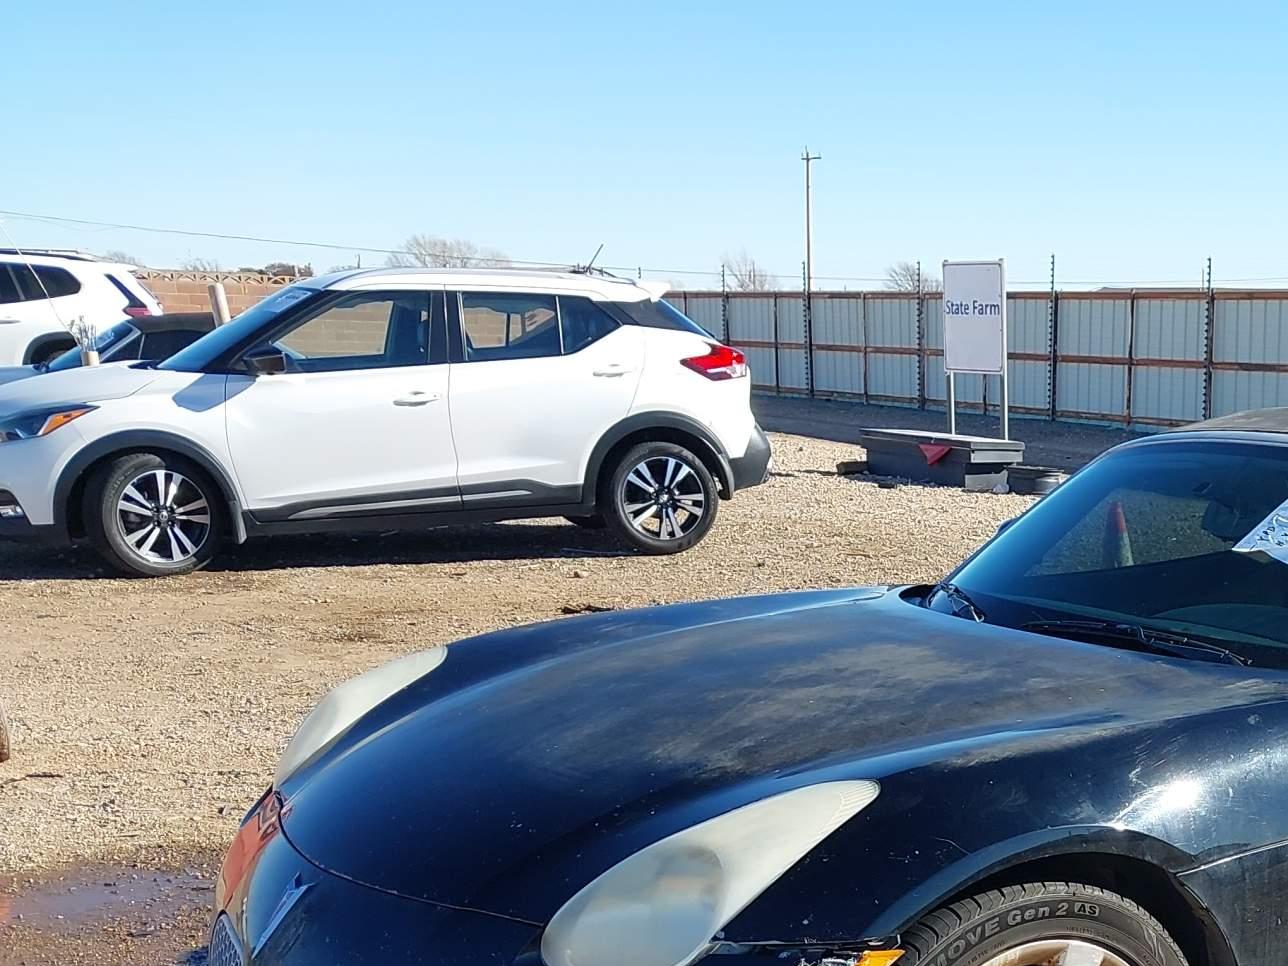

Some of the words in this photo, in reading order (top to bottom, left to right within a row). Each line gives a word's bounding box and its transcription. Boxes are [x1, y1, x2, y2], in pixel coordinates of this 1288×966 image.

[945, 300, 970, 315] State
[972, 300, 1000, 315] Farm
[1007, 904, 1050, 926] Gen
[1055, 902, 1069, 916] 2
[1075, 902, 1099, 916] AS
